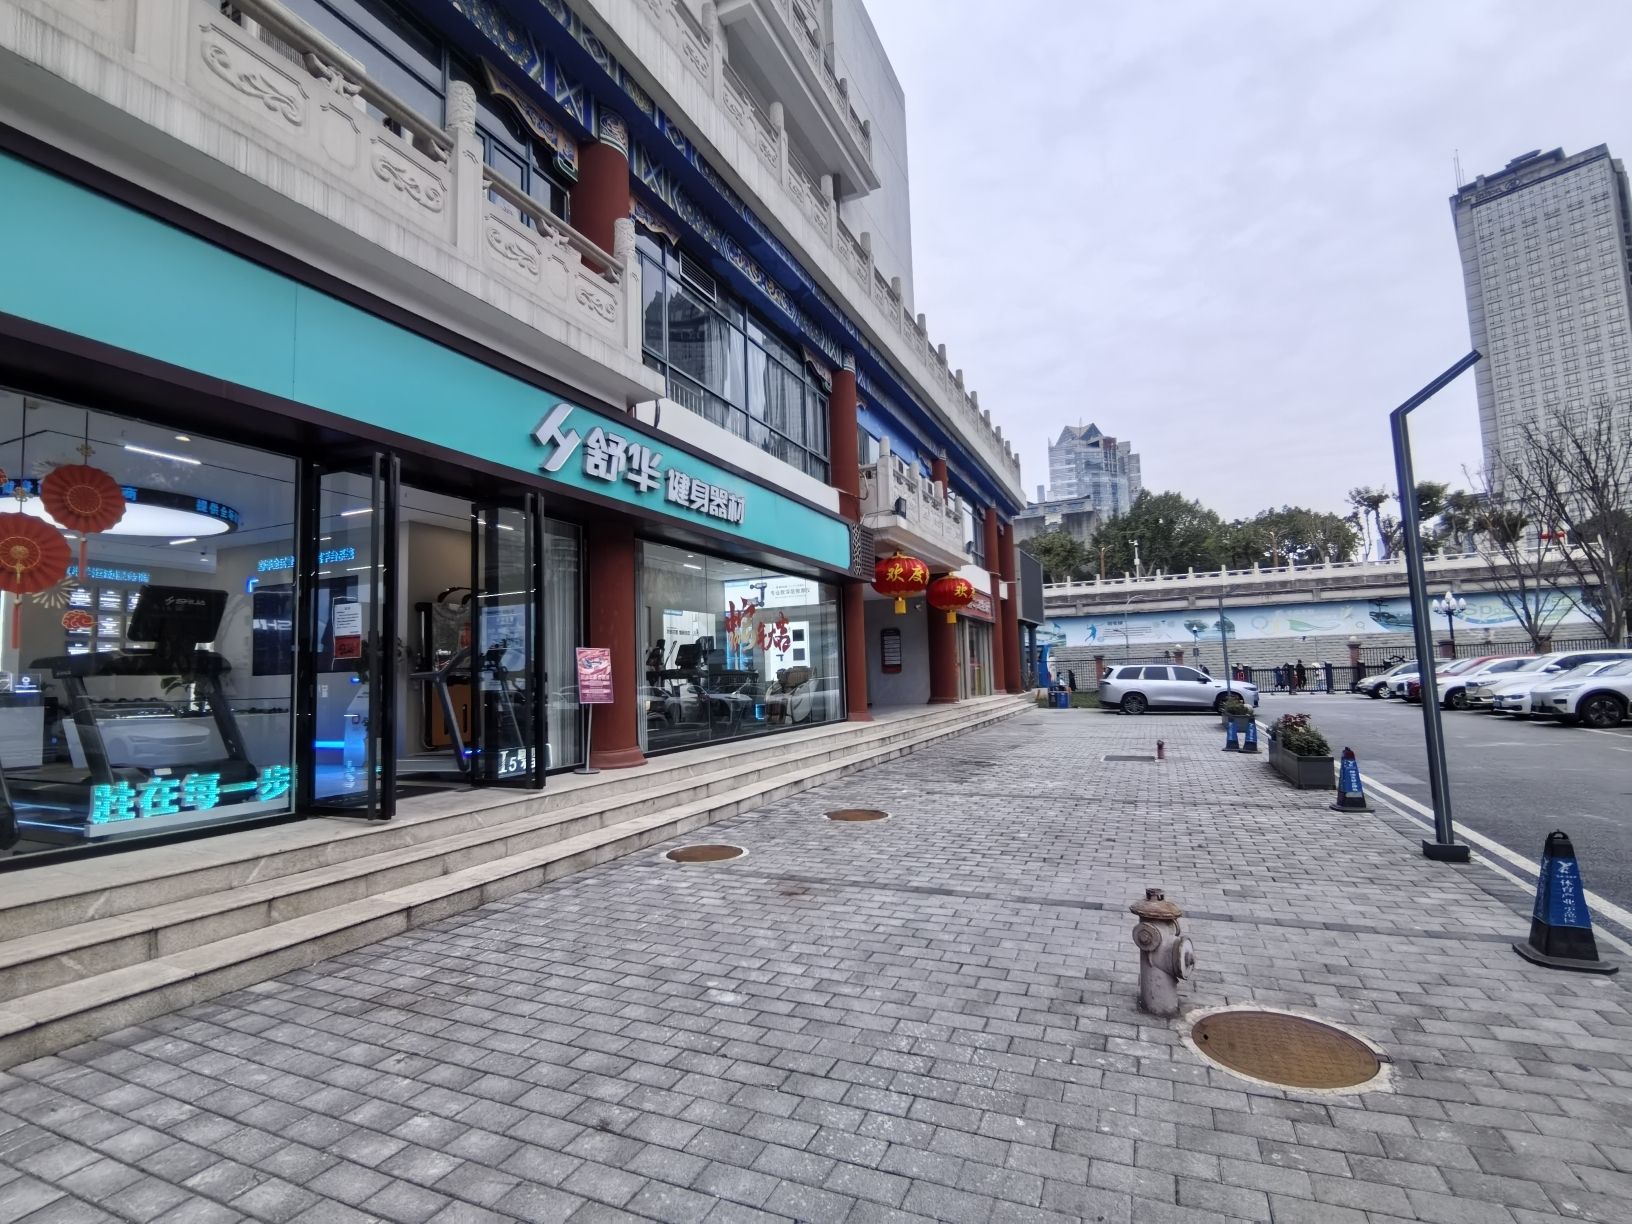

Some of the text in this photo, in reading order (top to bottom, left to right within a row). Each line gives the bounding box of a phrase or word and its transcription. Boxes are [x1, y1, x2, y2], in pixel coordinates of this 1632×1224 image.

[583, 427, 747, 526] 舒华 健身器材
[89, 765, 290, 824] 胜在每一步
